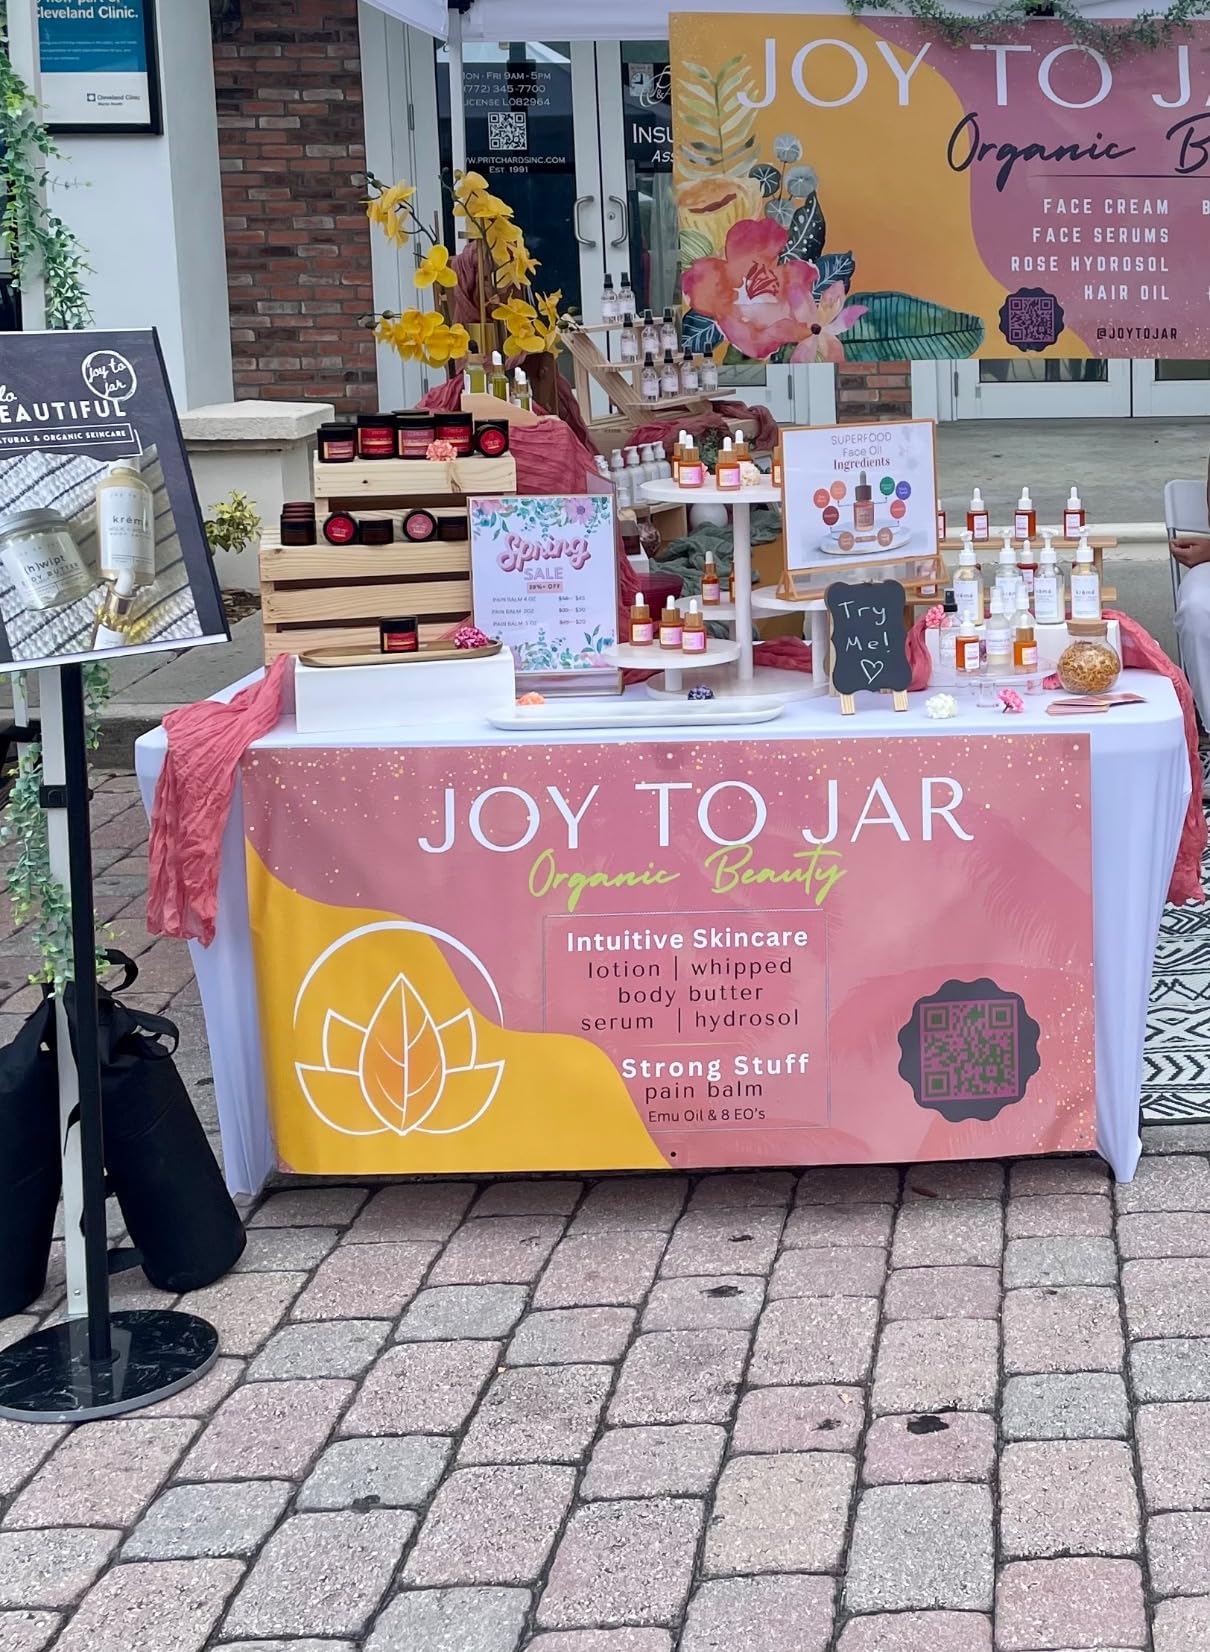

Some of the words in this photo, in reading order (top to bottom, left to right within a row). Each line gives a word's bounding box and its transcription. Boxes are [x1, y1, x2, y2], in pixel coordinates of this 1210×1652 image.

[98, 5, 138, 19] Clinic.
[737, 38, 931, 109] JOY
[970, 44, 1112, 109] TO
[1152, 45, 1210, 108] J
[466, 156, 566, 164] W.PRITCHARDSINC.COM
[948, 112, 1136, 192] Organic
[509, 165, 528, 174] 1991
[1043, 198, 1093, 215] FACE
[1104, 198, 1169, 215] CREAM
[1032, 226, 1082, 244] FACE
[1093, 226, 1169, 244] SERUMS
[1011, 255, 1059, 272] ROSE
[1070, 255, 1169, 272] HYDROSOL
[1084, 284, 1129, 301] HAIR
[1140, 284, 1170, 301] OIL
[1097, 327, 1178, 341] @JOYTOJAR
[88, 364, 109, 384] joy
[108, 357, 127, 374] to
[104, 379, 127, 398] jar
[0, 400, 127, 424] EAUTIFUL
[42, 431, 84, 442] ORGANIC
[85, 430, 127, 440] SKINCARE
[831, 432, 892, 446] SUPERFOOD
[842, 447, 867, 458] Face
[868, 445, 882, 456] Oil
[833, 457, 891, 473] Ingredients
[497, 532, 592, 573] Spring
[523, 566, 563, 581] SALE
[837, 600, 886, 626] Try
[845, 631, 891, 654] Me!
[417, 784, 600, 854] JOY
[634, 780, 767, 847] TO
[801, 776, 975, 846] JAR
[528, 848, 680, 912] Organic
[704, 842, 849, 906] Beauty
[567, 929, 684, 953] Intuitive
[692, 927, 809, 950] Skincare
[588, 961, 661, 979] lotion
[691, 956, 792, 980] whipped
[618, 986, 677, 1008] body
[688, 984, 764, 1004] butter
[580, 1015, 653, 1032] serum
[695, 1008, 799, 1033] hydrosol
[621, 1058, 722, 1082] Strong
[733, 1053, 810, 1076] Stuff
[645, 1082, 695, 1105] pain
[707, 1079, 763, 1100] balm
[648, 1110, 680, 1123] Emu
[683, 1109, 704, 1122] Oil
[707, 1109, 718, 1121] &
[720, 1109, 730, 1121] 8
[734, 1107, 766, 1121] EO's
